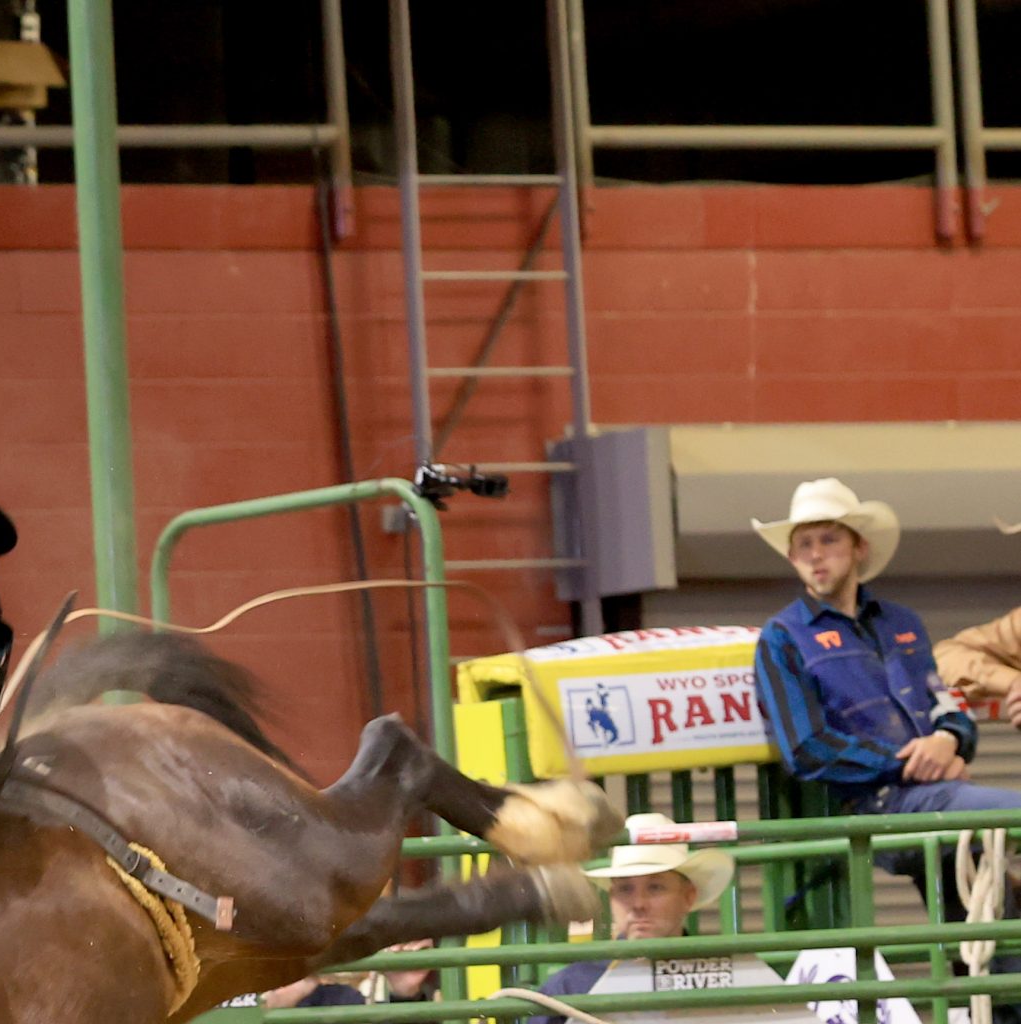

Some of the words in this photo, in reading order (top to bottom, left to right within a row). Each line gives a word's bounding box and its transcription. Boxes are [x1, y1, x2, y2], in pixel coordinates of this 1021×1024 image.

[656, 675, 707, 691] WYO
[655, 957, 733, 974] POWDER
[673, 971, 733, 991] RIVER
